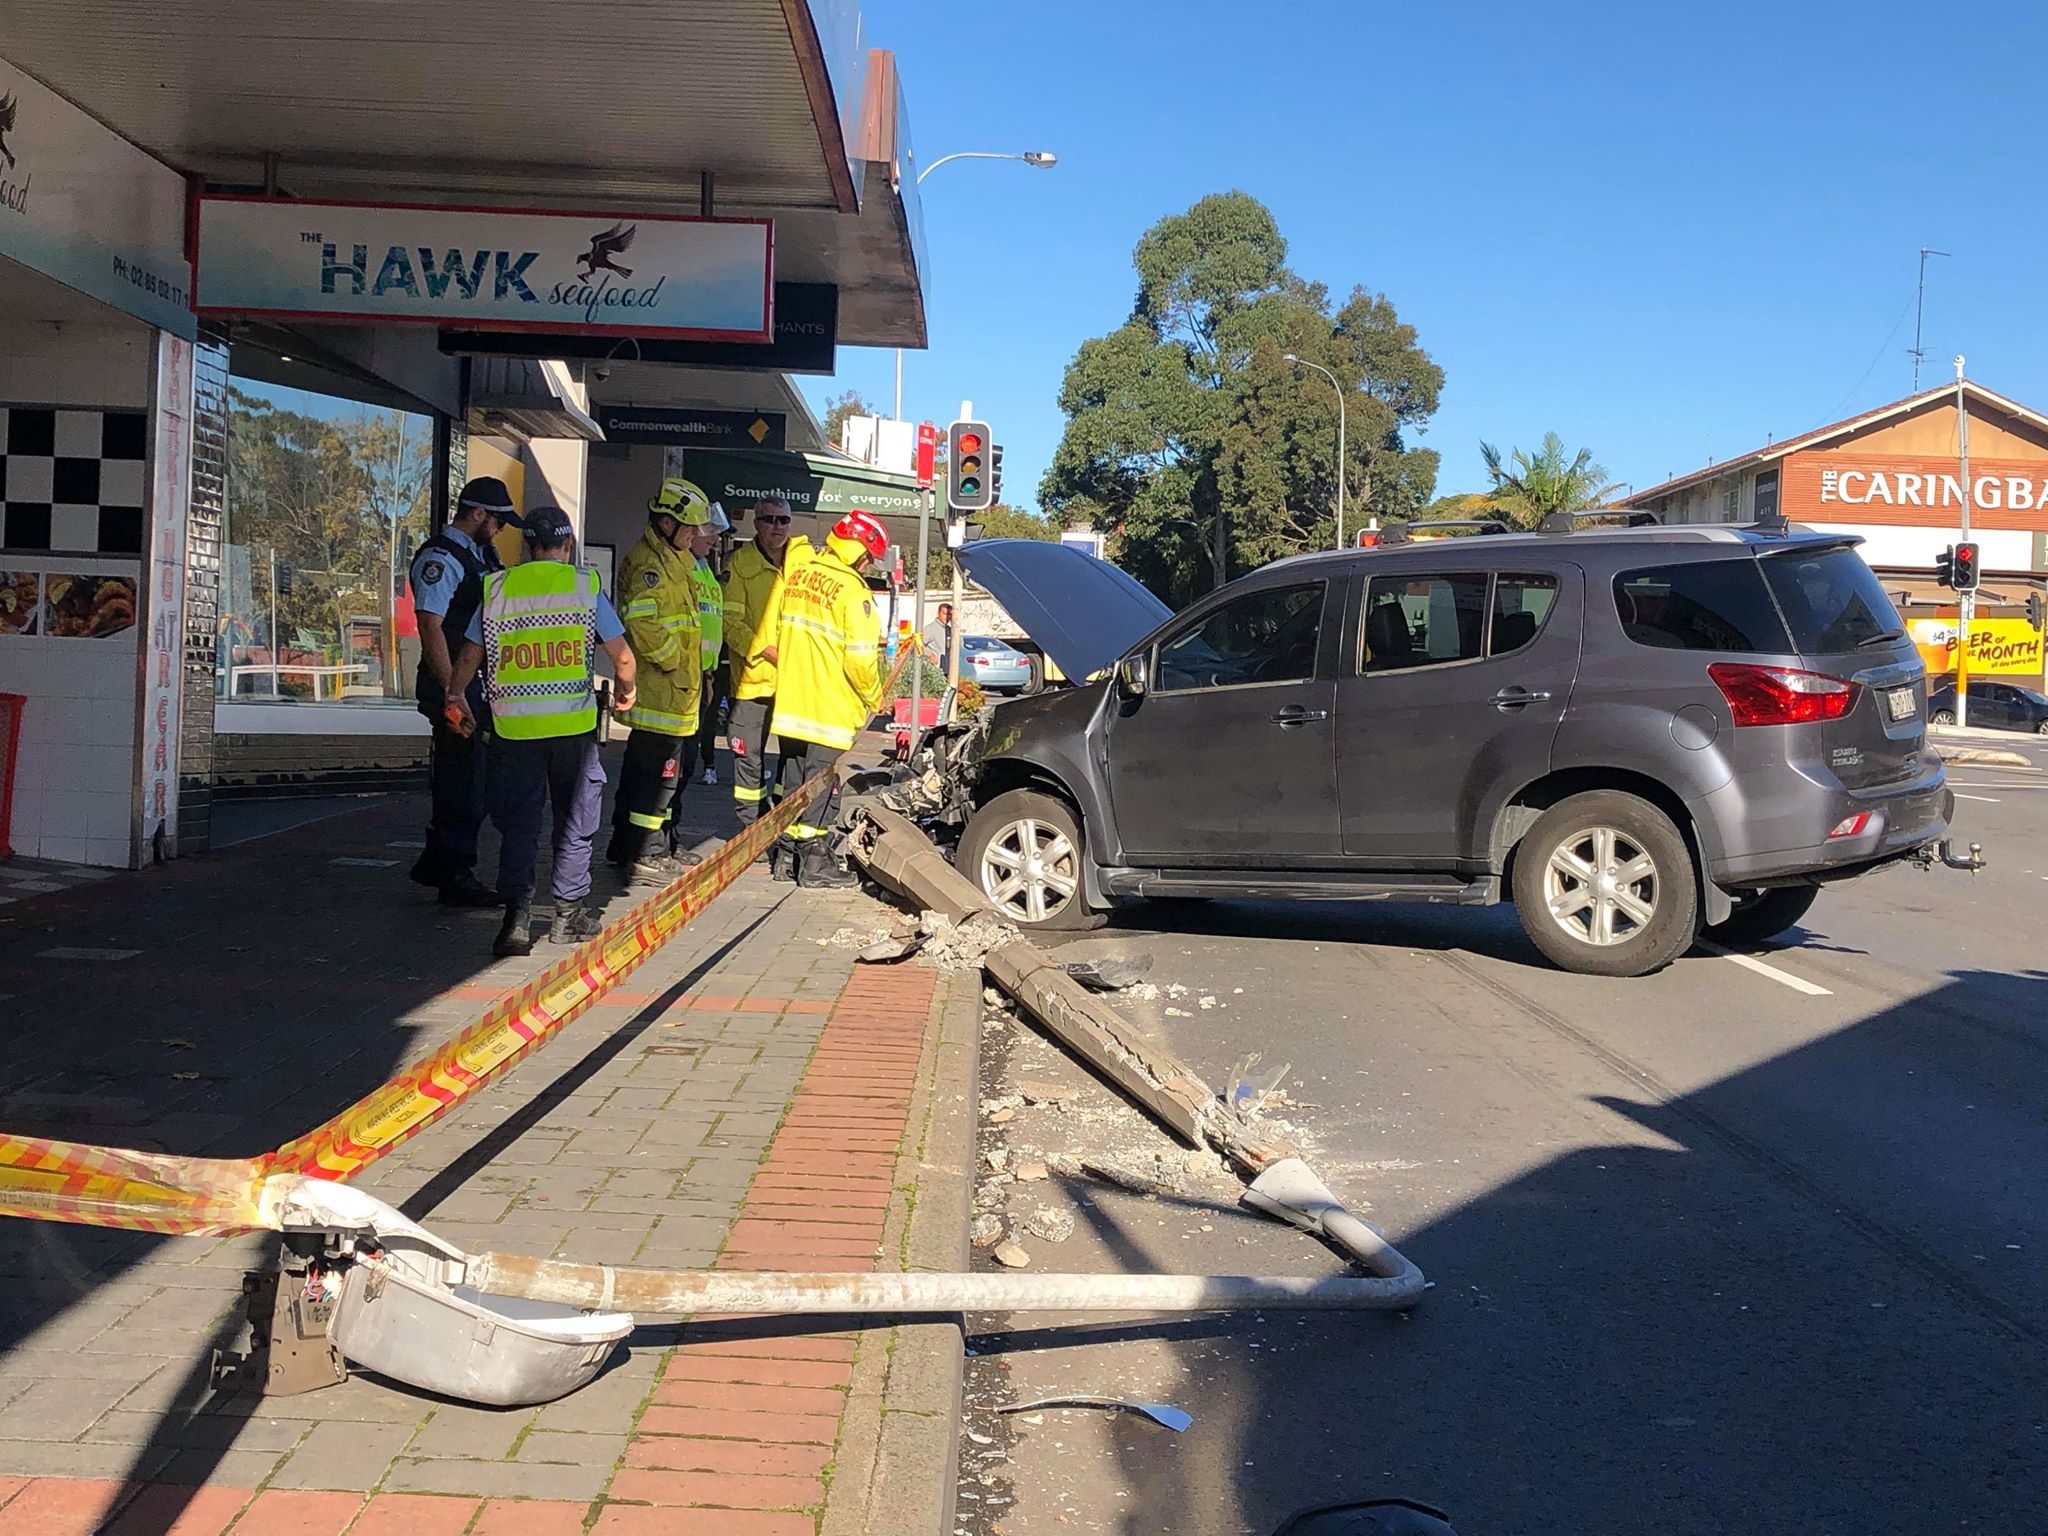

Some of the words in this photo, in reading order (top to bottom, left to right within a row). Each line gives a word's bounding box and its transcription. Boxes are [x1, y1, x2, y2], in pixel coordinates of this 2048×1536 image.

[130, 265, 144, 288] 02
[300, 231, 323, 244] THE
[320, 243, 541, 304] HAWK
[547, 276, 667, 323] seafood
[774, 322, 825, 335] HANTS
[609, 419, 733, 434] CommonwealthBank
[724, 484, 811, 503] Something
[818, 489, 843, 504] for
[849, 494, 922, 508] everyone
[1821, 470, 1838, 503] THE
[806, 571, 845, 601] RESCUE
[153, 609, 178, 651] AT
[1946, 632, 1993, 652] BER
[1995, 636, 2007, 644] OF
[499, 640, 584, 671] POLICE
[1978, 639, 2040, 661] MONTH
